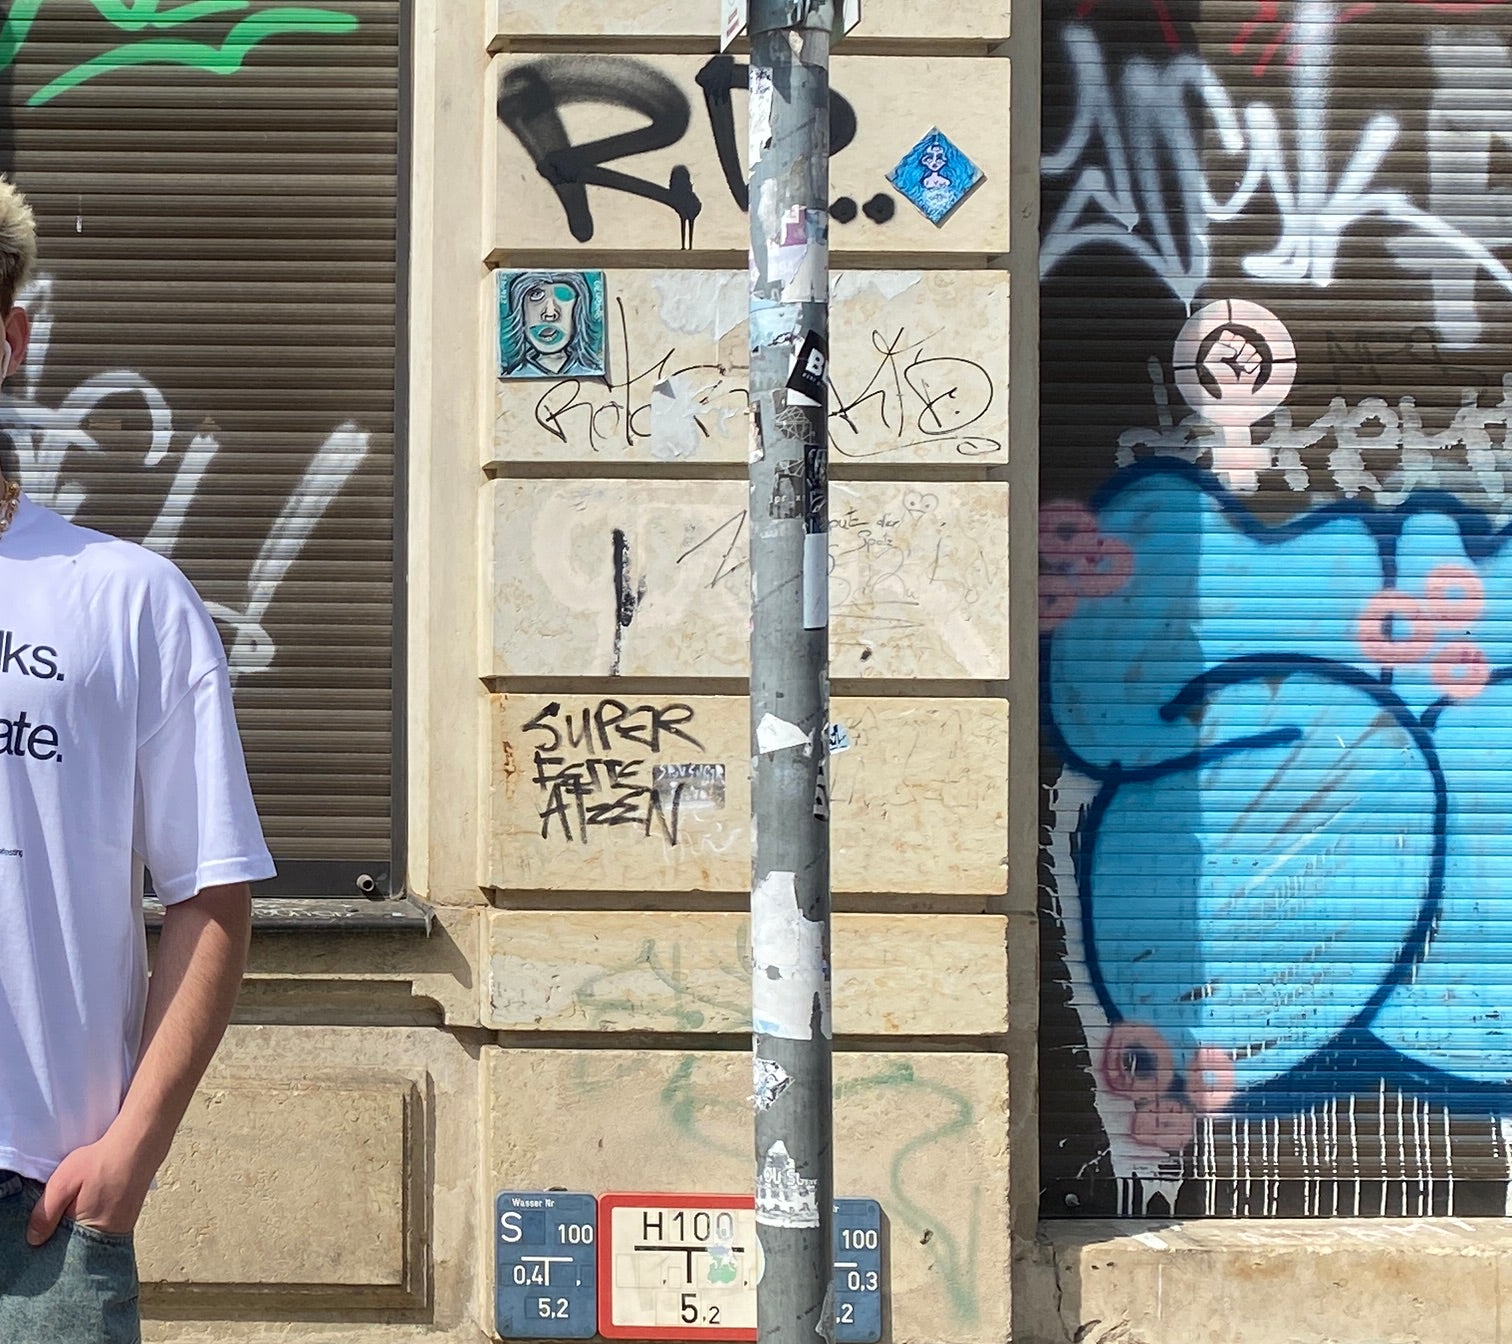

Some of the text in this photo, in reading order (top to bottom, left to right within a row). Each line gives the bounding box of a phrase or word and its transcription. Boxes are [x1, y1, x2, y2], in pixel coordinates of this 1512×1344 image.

[522, 698, 706, 754] SUPER
[512, 1198, 555, 1207] Wasser Nr
[501, 1211, 594, 1244] S 100
[842, 1229, 878, 1250] 100
[513, 1265, 544, 1286] 0,4
[848, 1271, 878, 1292] 0,3
[538, 1298, 569, 1319] 5,2
[681, 1293, 720, 1325] 5,2
[835, 1303, 854, 1324] ,2
